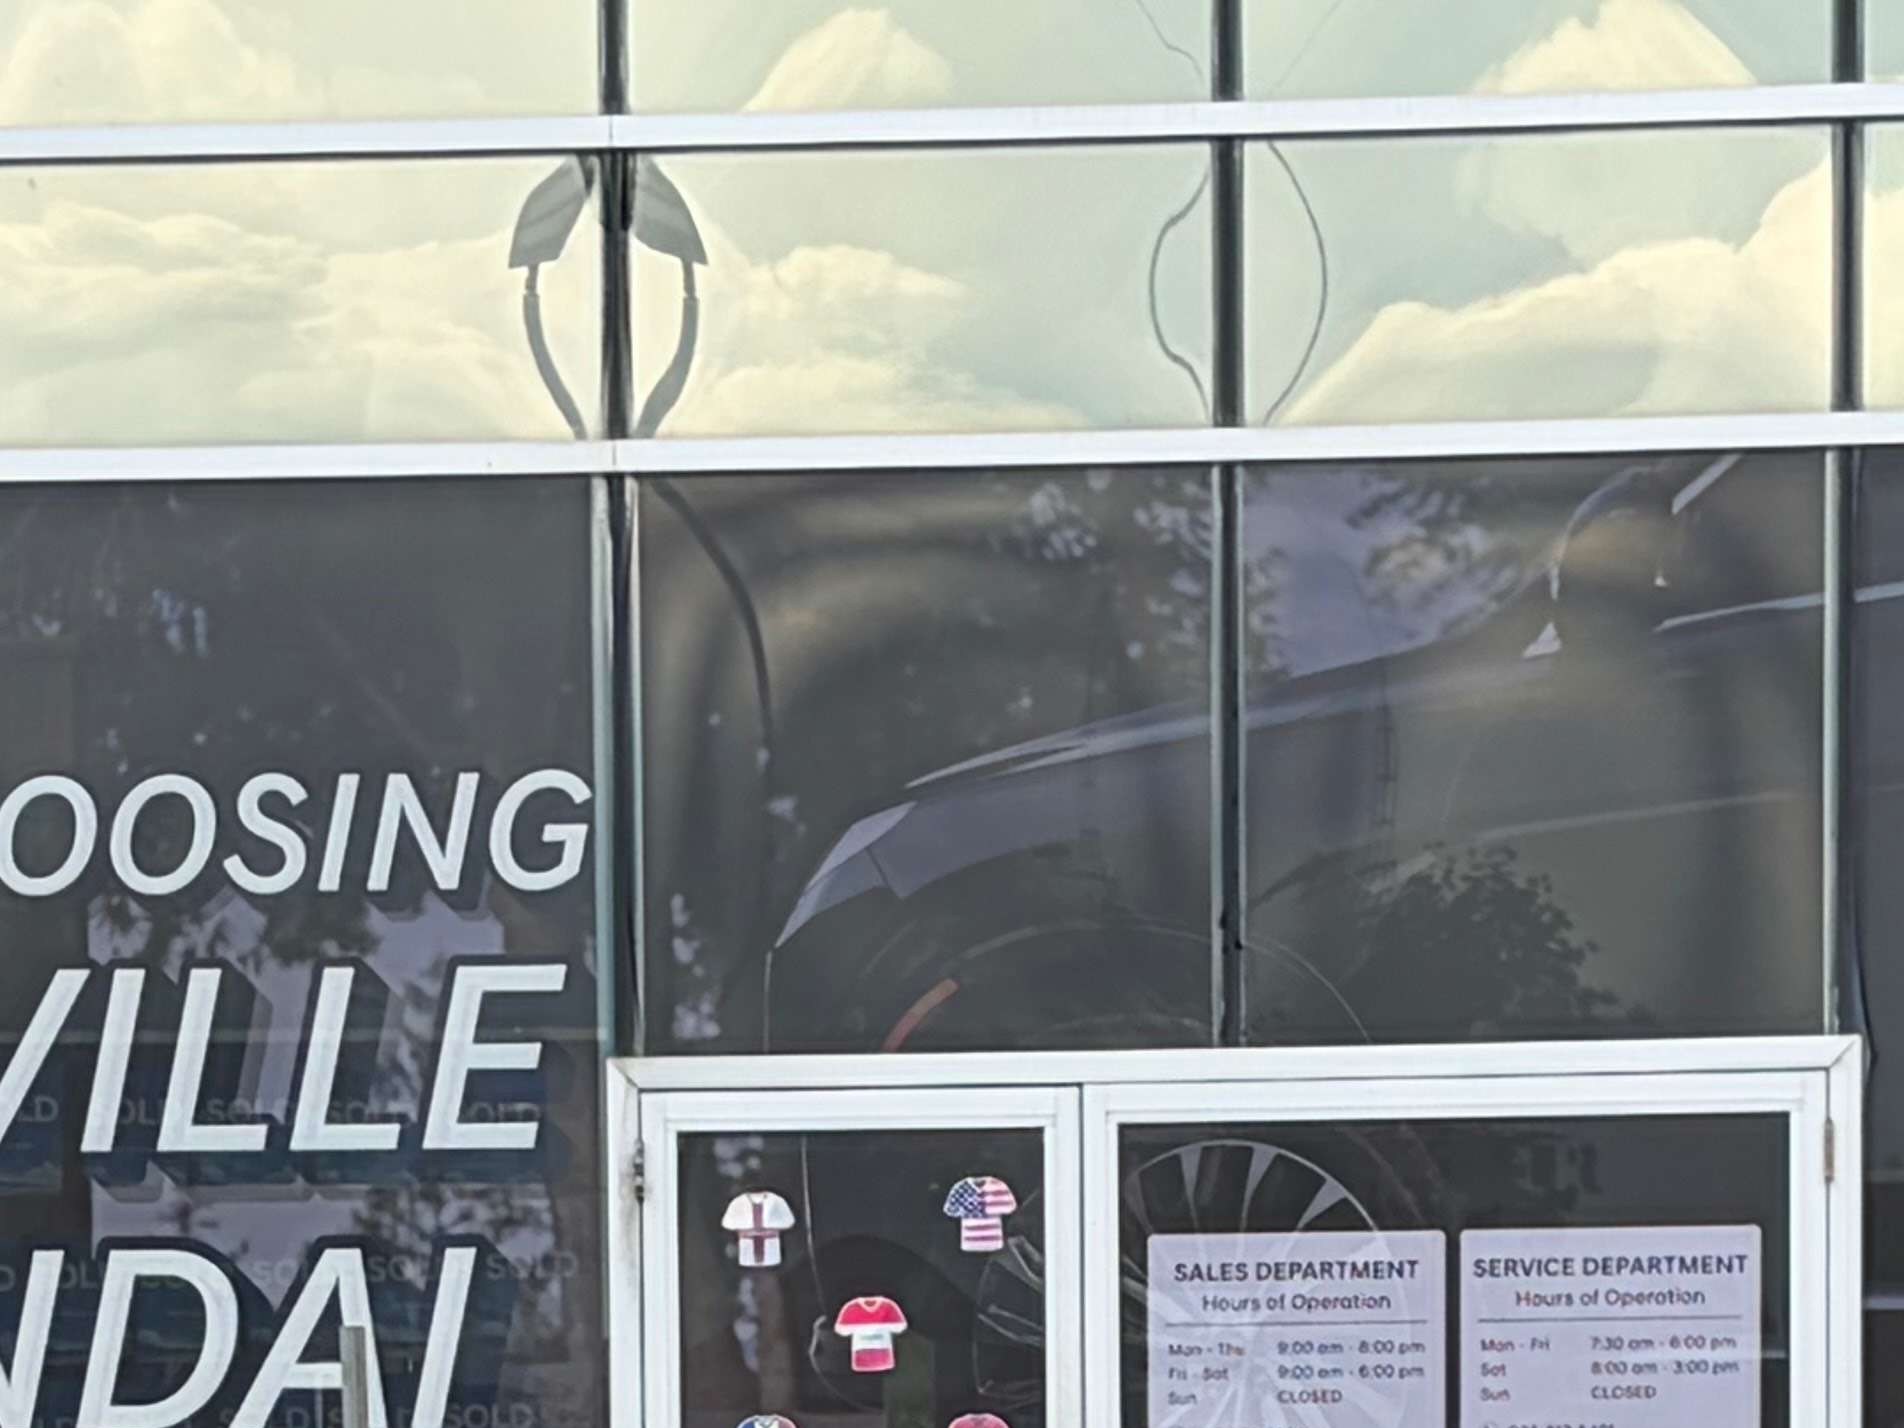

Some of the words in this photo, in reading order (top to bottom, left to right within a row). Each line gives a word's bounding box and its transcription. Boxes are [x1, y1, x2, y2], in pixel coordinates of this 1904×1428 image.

[1174, 1262, 1249, 1281] SALES
[1256, 1259, 1419, 1281] DEPARTMENT
[1472, 1258, 1576, 1279] SERVICE
[1582, 1255, 1749, 1277] DEPARTMENT
[1202, 1295, 1262, 1312] Hours
[1266, 1293, 1286, 1310] of
[1291, 1292, 1392, 1312] Operation
[1516, 1291, 1575, 1307] Hours
[1579, 1289, 1599, 1306] of
[1604, 1288, 1706, 1308] Operation
[1276, 1388, 1344, 1405] CLOSED
[1591, 1385, 1657, 1401] CLOSED
